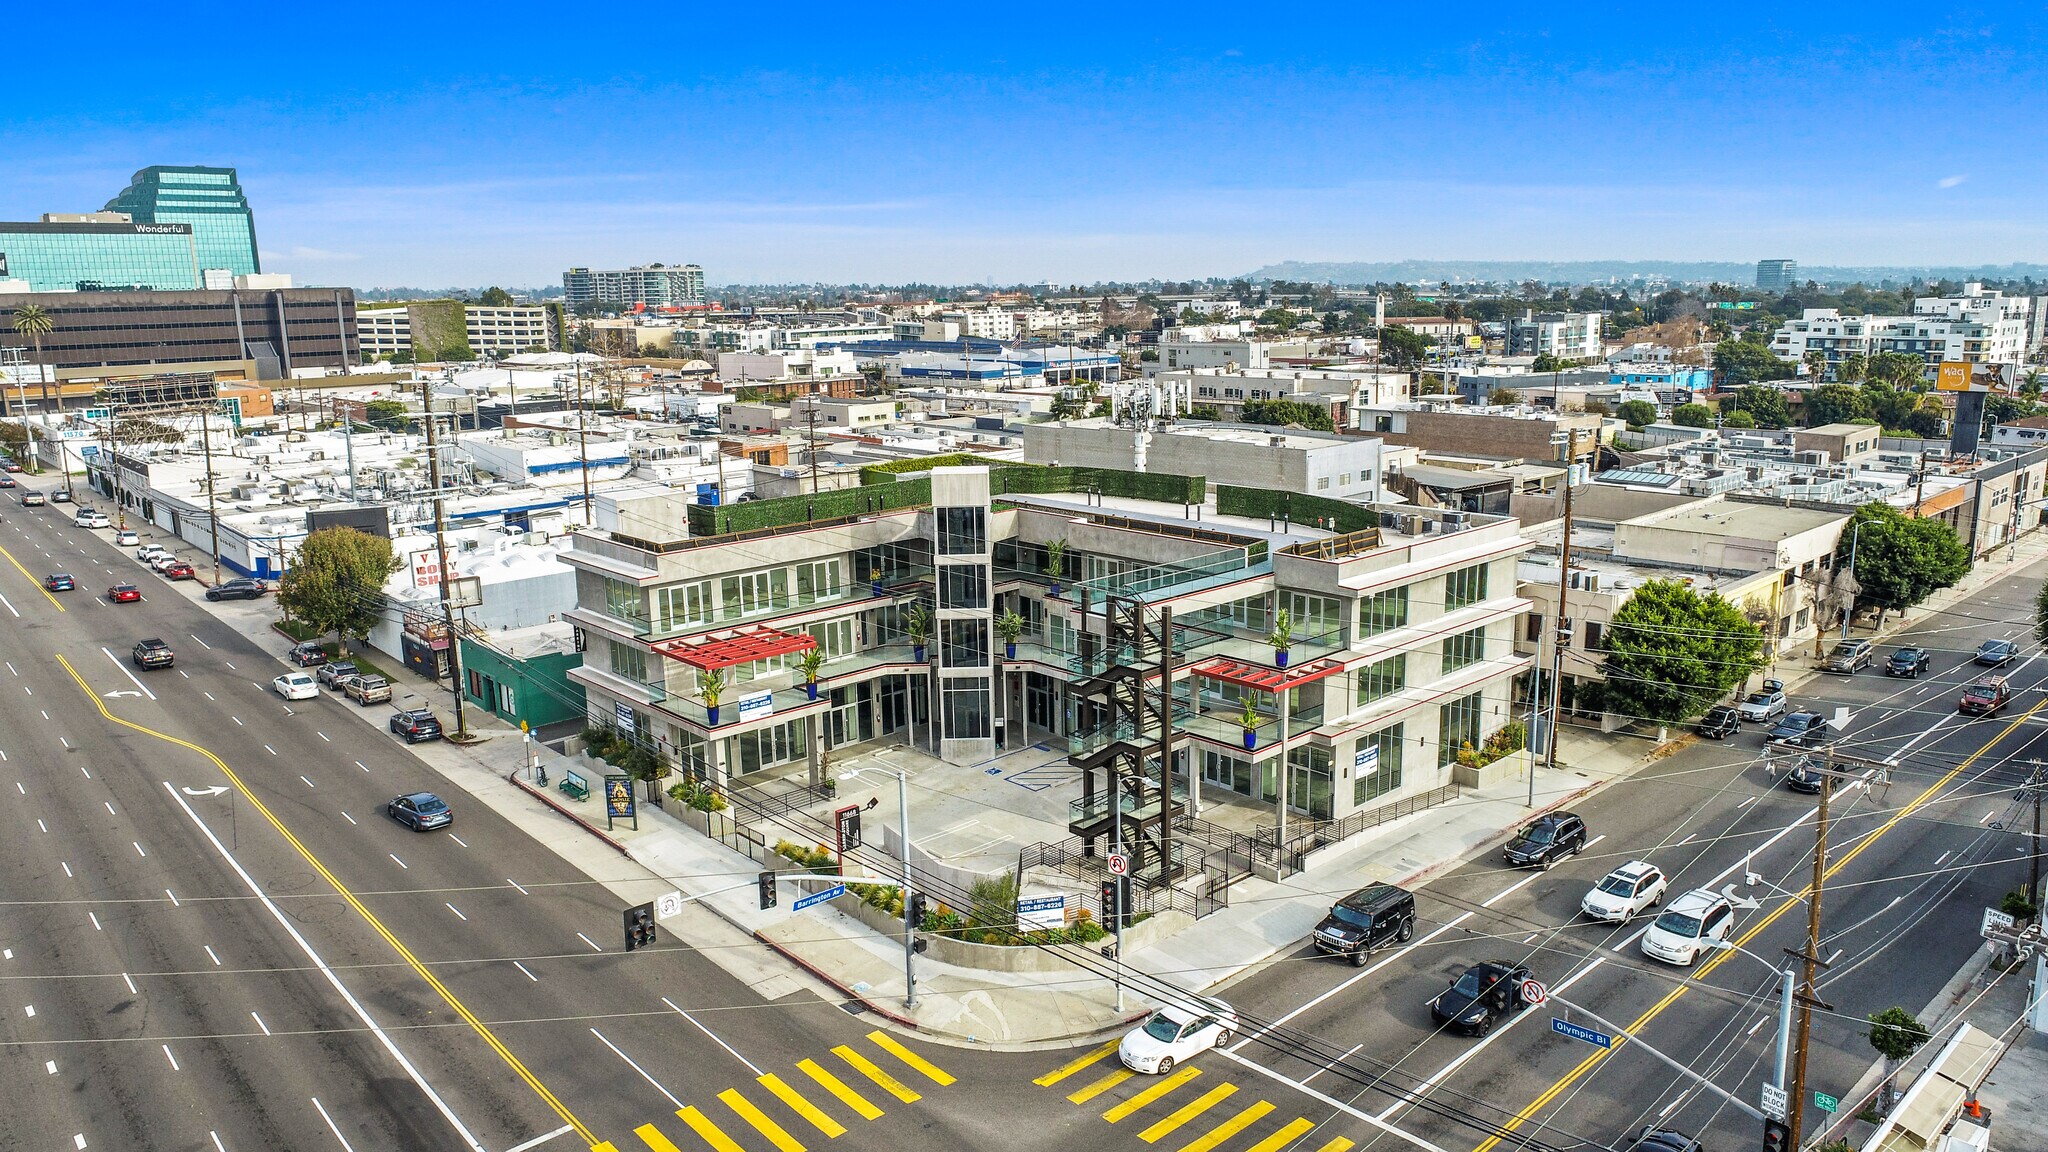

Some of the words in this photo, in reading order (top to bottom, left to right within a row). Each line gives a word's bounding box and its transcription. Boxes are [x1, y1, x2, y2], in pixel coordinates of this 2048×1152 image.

[135, 224, 184, 233] Wonderful
[416, 561, 457, 575] BOY
[417, 572, 460, 587] SHP
[797, 893, 831, 908] Barrington
[1987, 911, 2011, 923] SPEED
[1557, 1022, 1594, 1040] Olympic
[1597, 1035, 1606, 1044] Bl
[1764, 1087, 1773, 1095] DO
[1774, 1091, 1785, 1100] NOT
[1763, 1095, 1784, 1109] BLOCK
